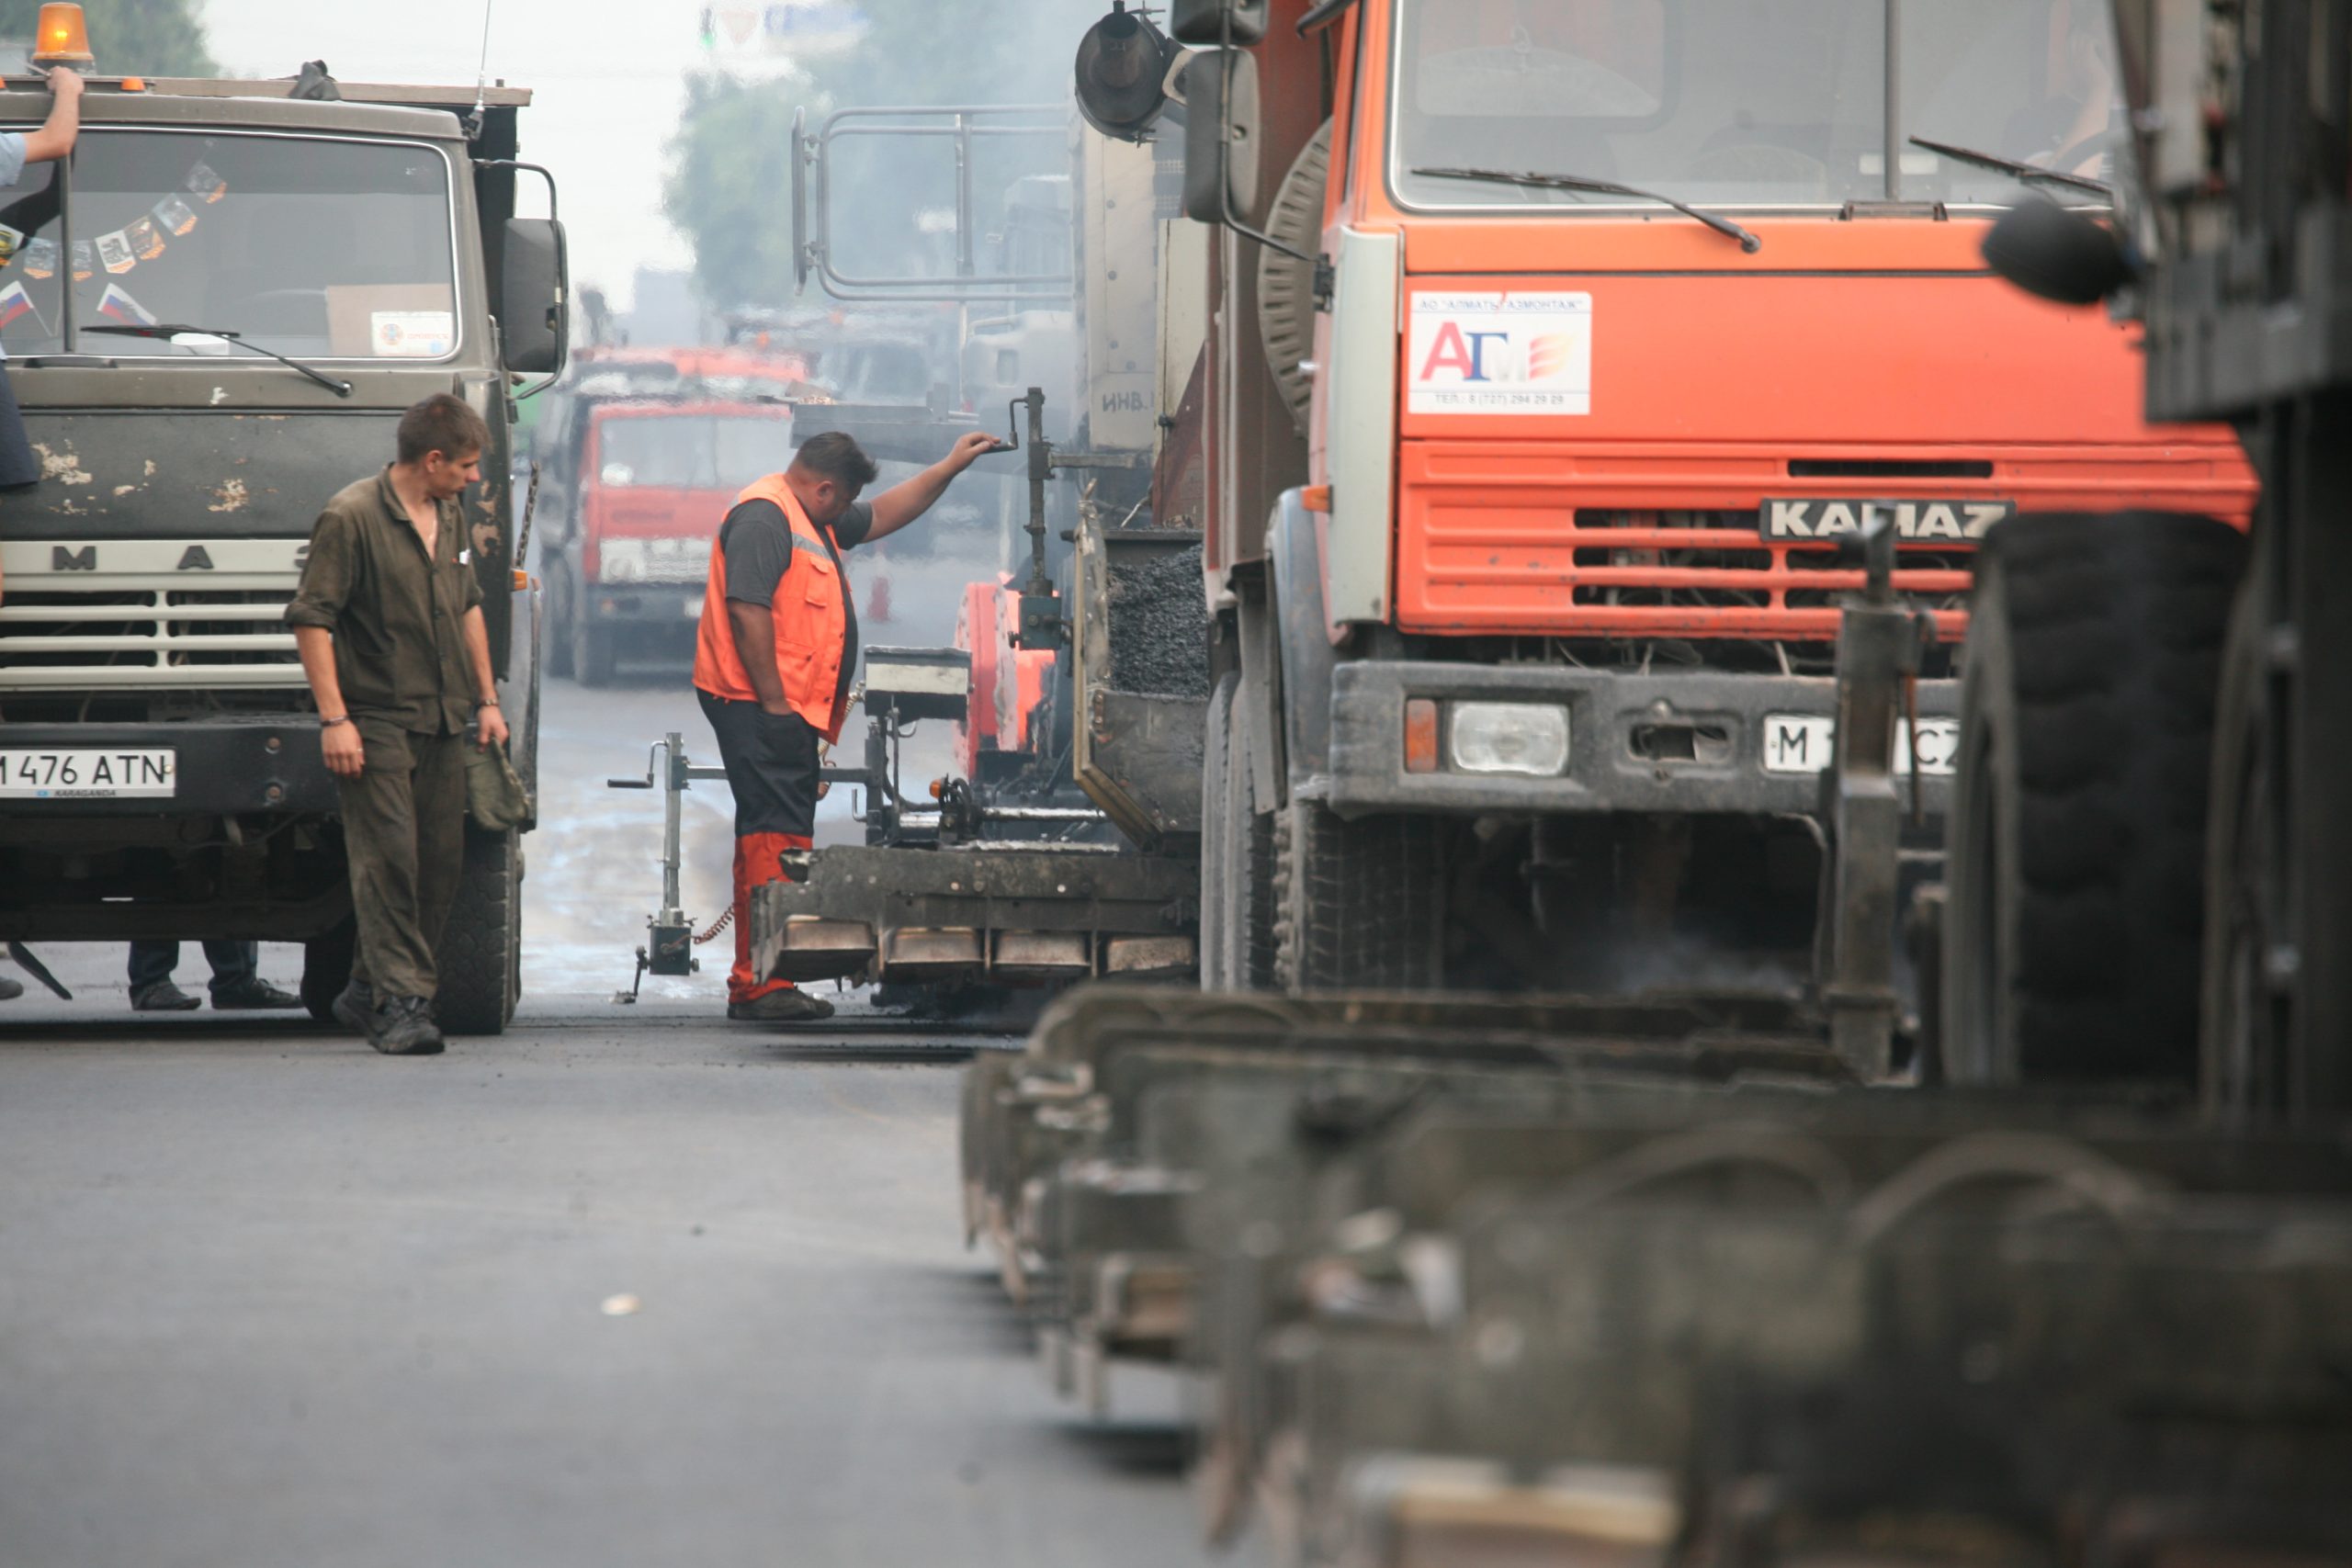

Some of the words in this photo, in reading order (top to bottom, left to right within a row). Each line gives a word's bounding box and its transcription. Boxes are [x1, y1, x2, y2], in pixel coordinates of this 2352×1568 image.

[1779, 726, 1807, 764] M
[18, 755, 78, 785] 476
[92, 755, 165, 785] ATN
[54, 789, 117, 797] KARAGANDA
